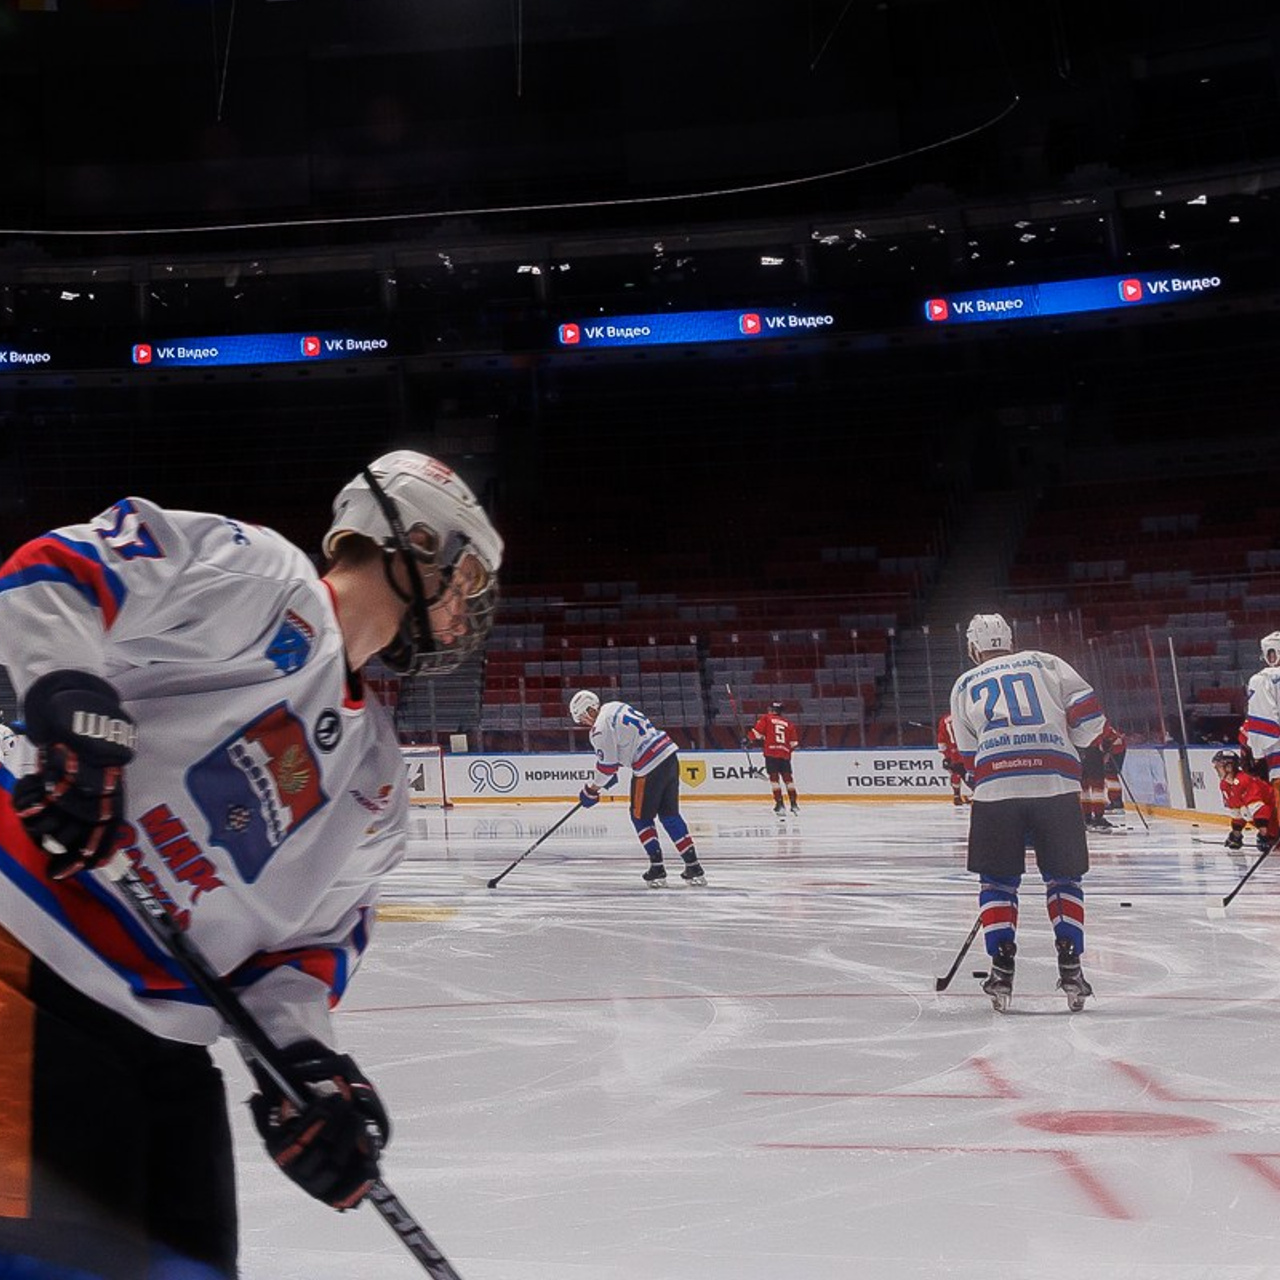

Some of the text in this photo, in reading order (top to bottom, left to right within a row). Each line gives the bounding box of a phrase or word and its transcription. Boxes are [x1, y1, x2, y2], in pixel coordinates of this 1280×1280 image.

[1147, 276, 1221, 293] VK Видео
[953, 299, 1023, 313] VK Видео
[766, 315, 833, 328] VK Видео
[585, 327, 650, 338] VK Видео
[325, 339, 387, 351] VK Видео
[10, 351, 50, 364] Видео
[157, 348, 218, 359] VK Видео
[970, 672, 1047, 734] 20
[774, 724, 786, 744] 5
[873, 760, 934, 771] ВРЕМЯ
[468, 759, 595, 793] 90 НОРНИКЕЛ
[847, 775, 949, 787] ПОБЕЖДАТ
